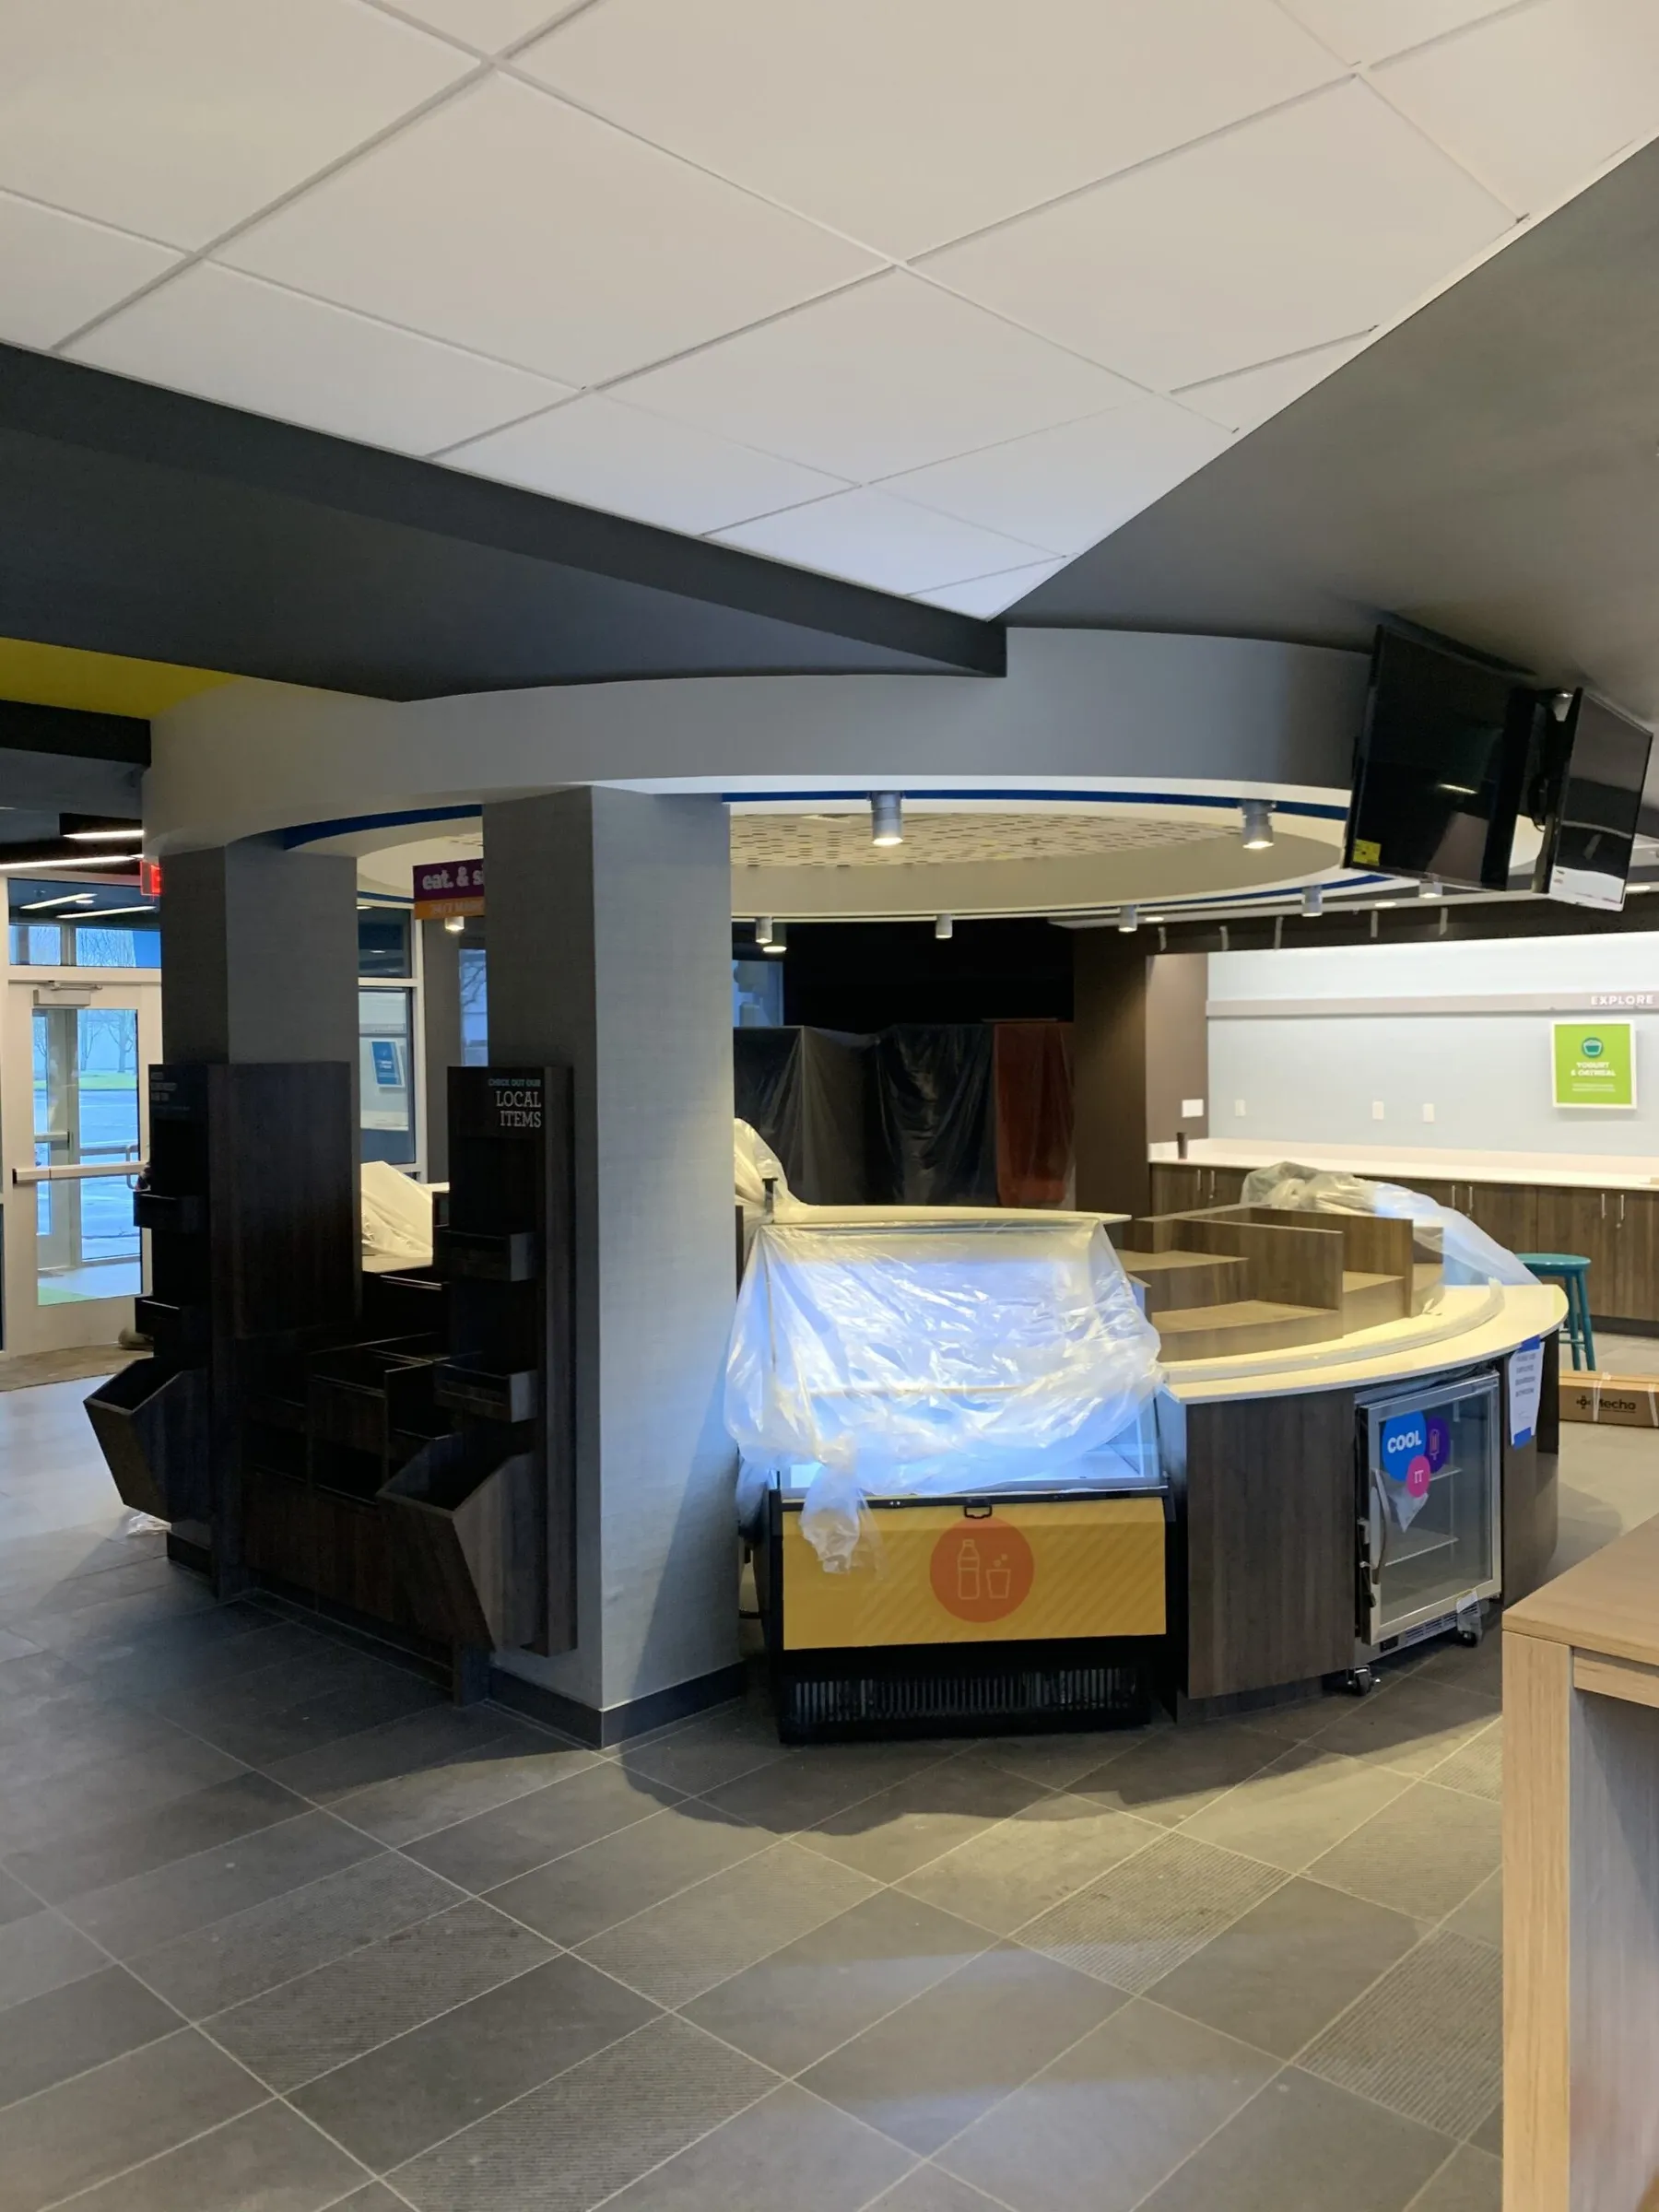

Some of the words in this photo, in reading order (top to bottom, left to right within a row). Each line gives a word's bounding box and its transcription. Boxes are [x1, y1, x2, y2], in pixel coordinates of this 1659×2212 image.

[422, 869, 453, 890] eat.
[456, 865, 469, 887] &
[1591, 994, 1653, 1006] EXPLORE
[496, 1090, 542, 1108] LOCAL
[500, 1110, 542, 1128] ITEMS
[1387, 1430, 1422, 1453] COOL
[1414, 1469, 1424, 1484] IT
